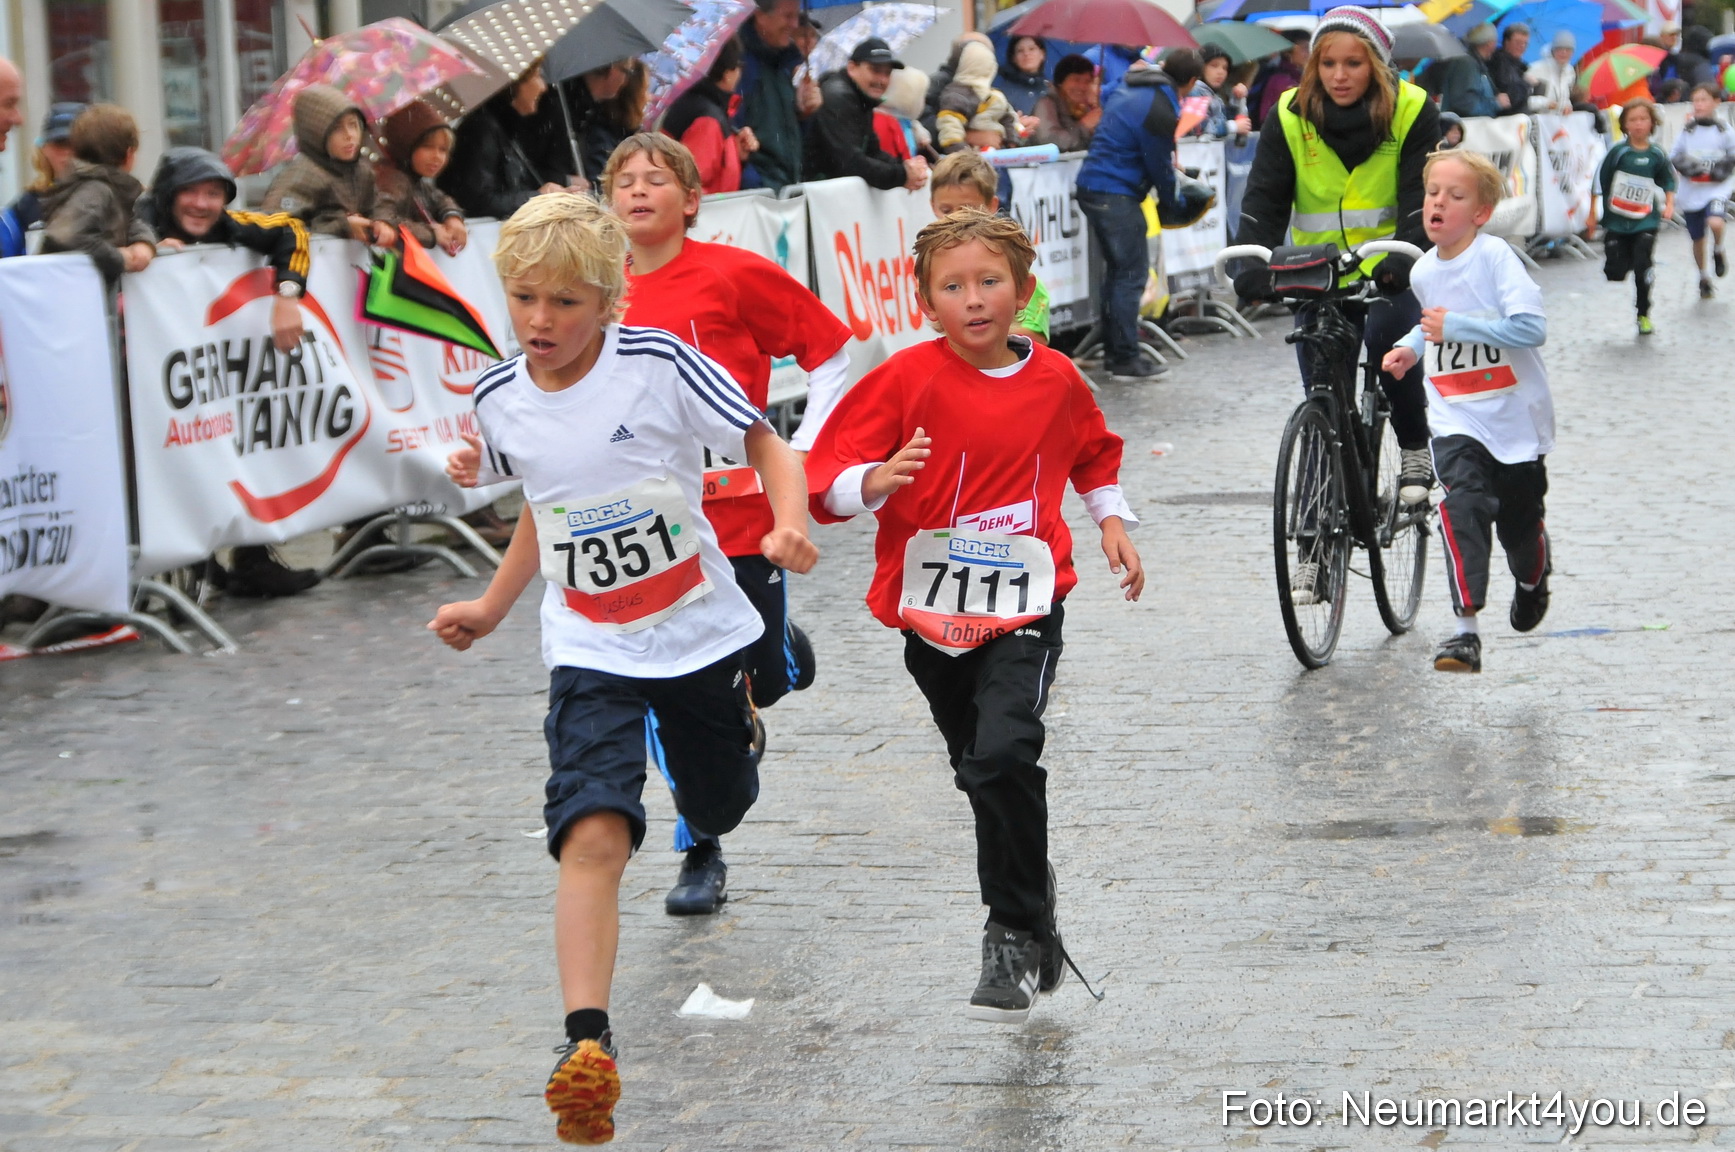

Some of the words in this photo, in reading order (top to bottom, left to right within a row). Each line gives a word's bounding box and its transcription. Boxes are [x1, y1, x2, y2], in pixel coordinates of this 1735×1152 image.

[1618, 183, 1651, 202] 7097
[834, 217, 923, 341] Oberb
[161, 330, 323, 411] GERHART
[232, 383, 354, 457] JÄNIG
[567, 499, 633, 527] BOCK
[978, 513, 1014, 532] DEHN
[553, 514, 678, 589] 7351
[949, 538, 1011, 558] BOCK
[921, 562, 1030, 614] 7111
[907, 597, 914, 606] 6
[942, 620, 1006, 643] Tobias
[1025, 629, 1042, 638] JAKO
